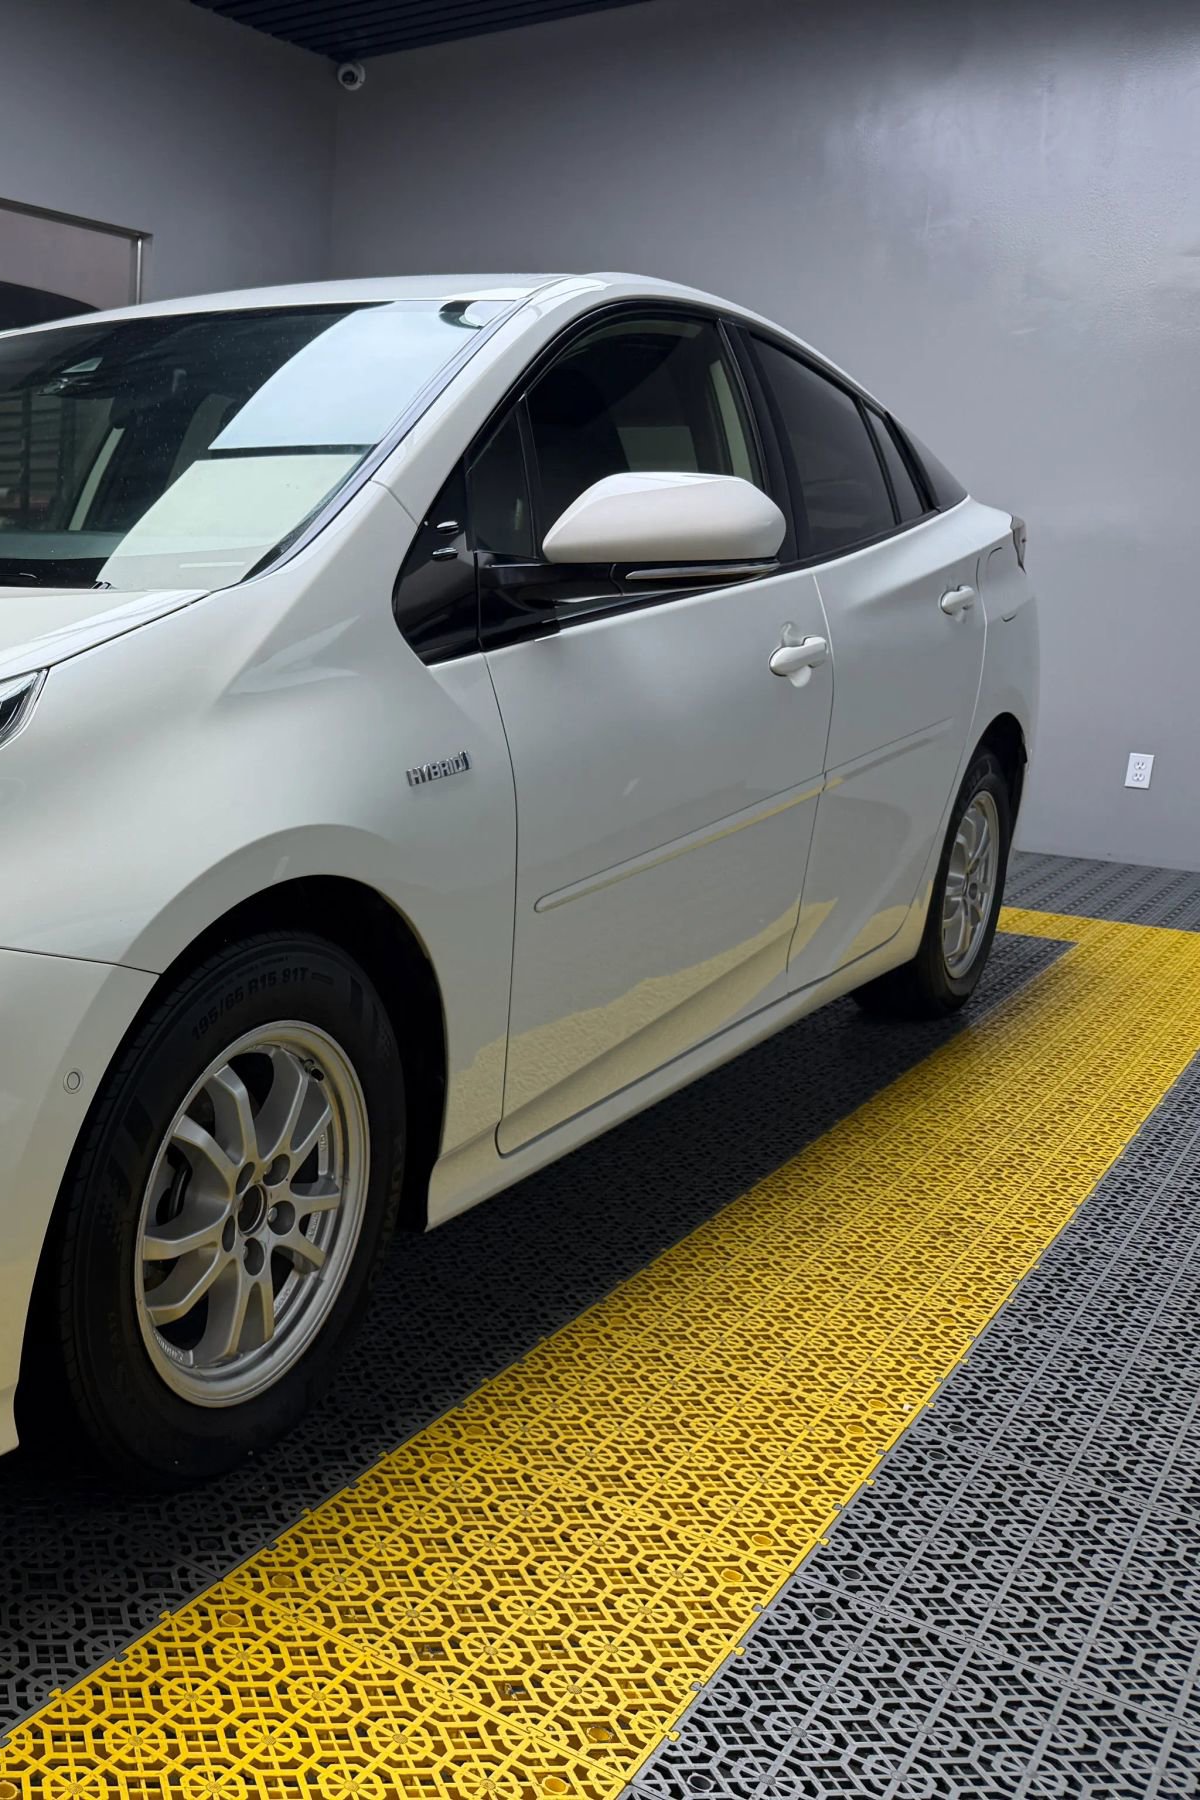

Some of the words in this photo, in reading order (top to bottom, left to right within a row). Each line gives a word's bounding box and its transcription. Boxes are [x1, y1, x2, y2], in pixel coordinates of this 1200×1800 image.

[406, 751, 469, 786] HYBRID
[192, 986, 244, 1040] 195/65
[248, 971, 277, 994] R15
